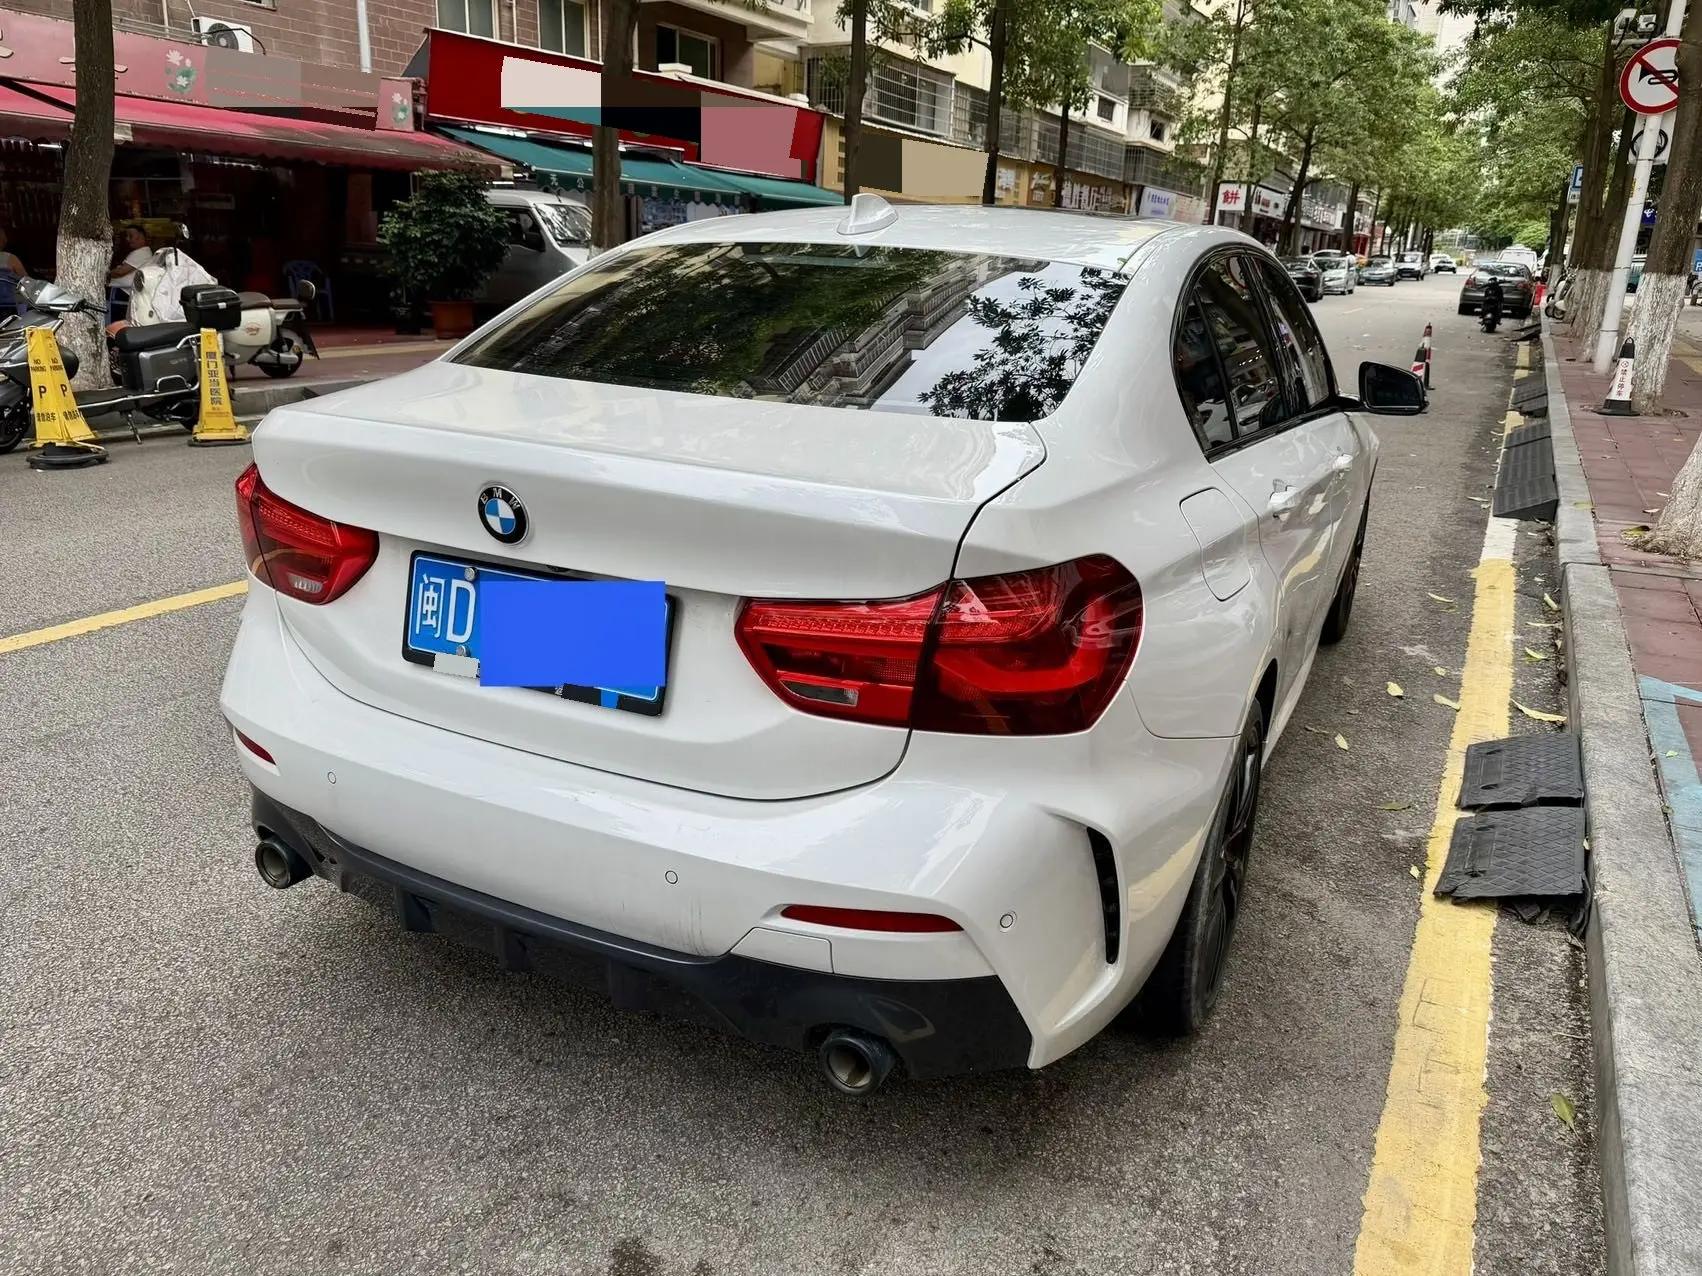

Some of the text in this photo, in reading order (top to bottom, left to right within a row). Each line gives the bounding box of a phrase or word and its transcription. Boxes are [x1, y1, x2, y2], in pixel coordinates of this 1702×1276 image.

[38, 385, 47, 399] P
[60, 383, 68, 397] P
[1616, 369, 1628, 397] 禁止停车
[480, 487, 521, 510] BMW
[415, 572, 477, 644] 闽D
